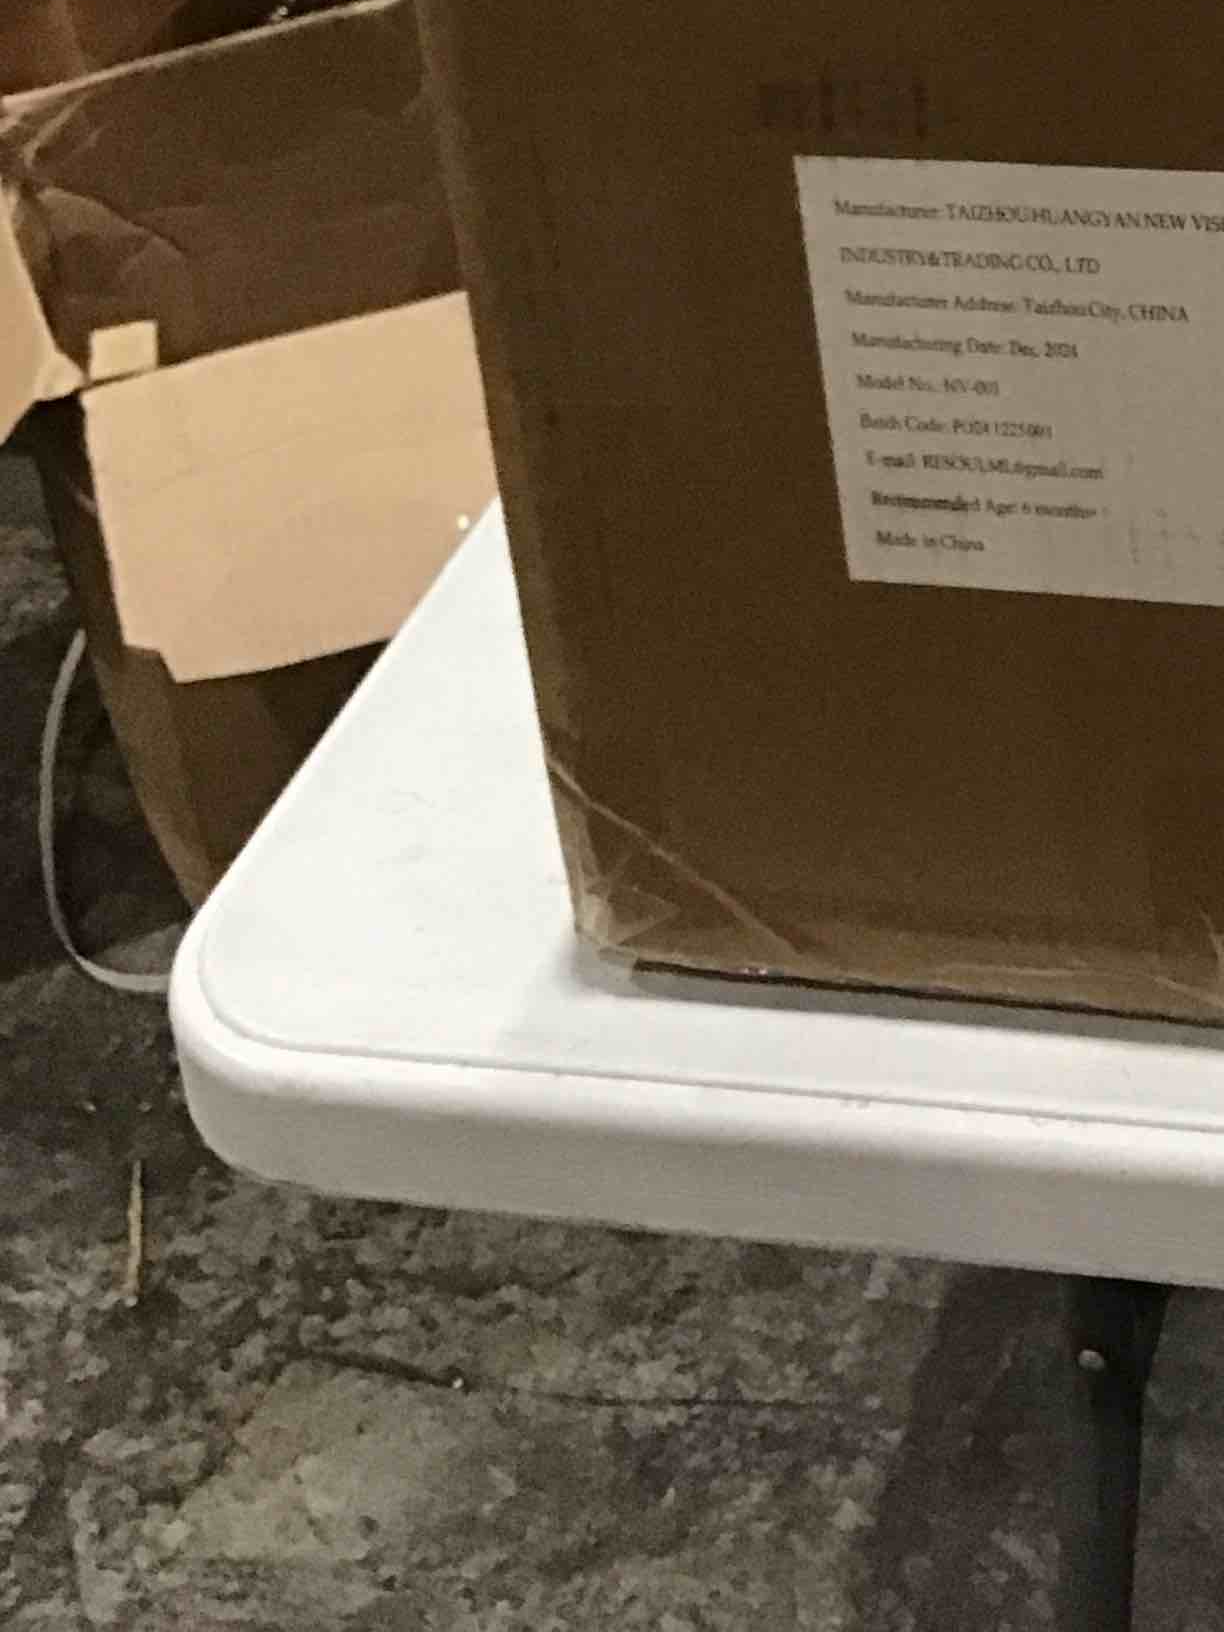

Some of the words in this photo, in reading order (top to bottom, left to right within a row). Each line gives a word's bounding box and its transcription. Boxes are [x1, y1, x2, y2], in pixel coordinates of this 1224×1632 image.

[833, 199, 940, 219] Manufacturer:
[945, 204, 1030, 223] TAIZHOU
[1032, 207, 1140, 229] HUANGYAN
[1143, 212, 1186, 230] NEW
[1128, 304, 1191, 324] CHINA
[851, 330, 962, 356] Manufacturing
[856, 373, 905, 391] Model
[860, 412, 900, 431] Batch
[876, 528, 917, 547] Made
[921, 532, 938, 549] in
[939, 533, 985, 553] China
